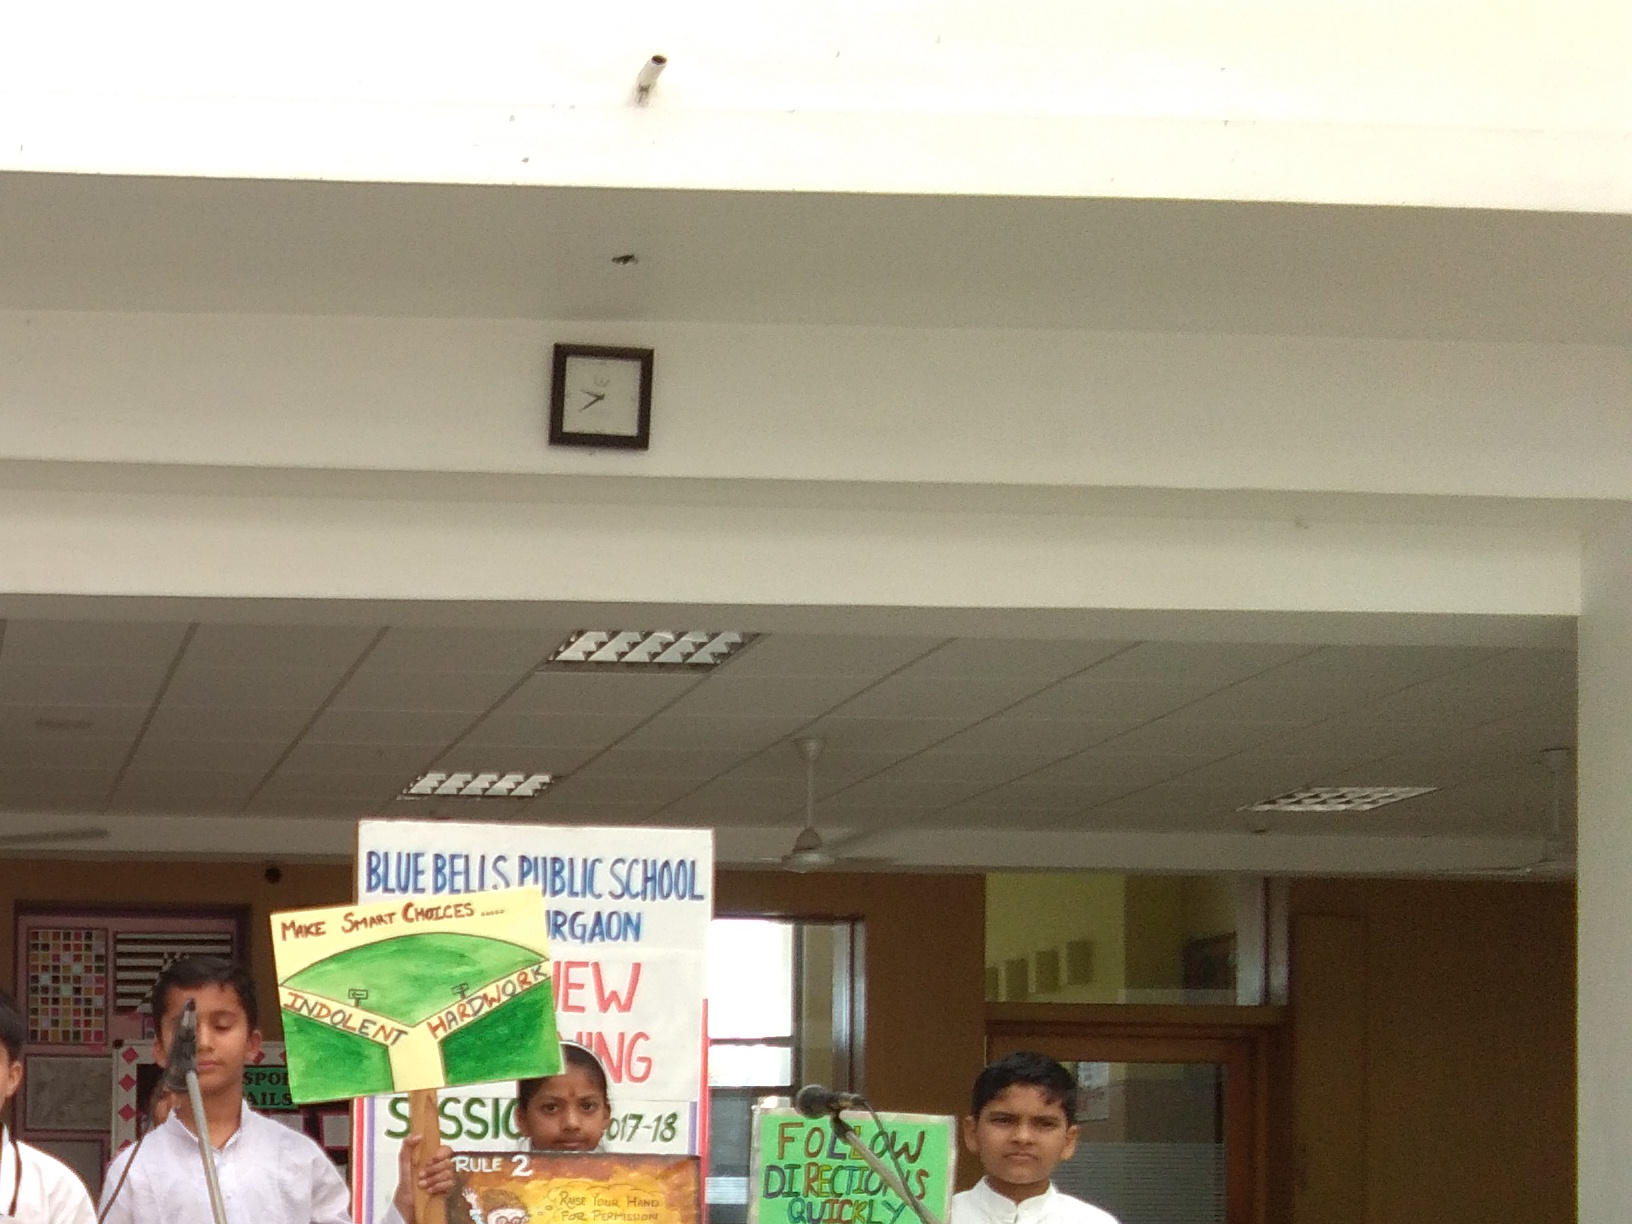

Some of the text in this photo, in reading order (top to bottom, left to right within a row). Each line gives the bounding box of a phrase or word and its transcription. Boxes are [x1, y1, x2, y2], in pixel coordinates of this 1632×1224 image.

[366, 850, 704, 901] BLUE BELLS PUBLIC SCHOOL
[280, 920, 327, 941] MAKE
[341, 911, 397, 934] SMART
[401, 902, 475, 924] CHOICES
[544, 909, 642, 944] RGAON
[283, 990, 409, 1047] INDOLENT
[426, 963, 549, 1040] HARDWORK
[605, 1112, 678, 1143] 017-18
[777, 1121, 926, 1165] FOLLOW
[451, 1154, 534, 1177] RULE 2
